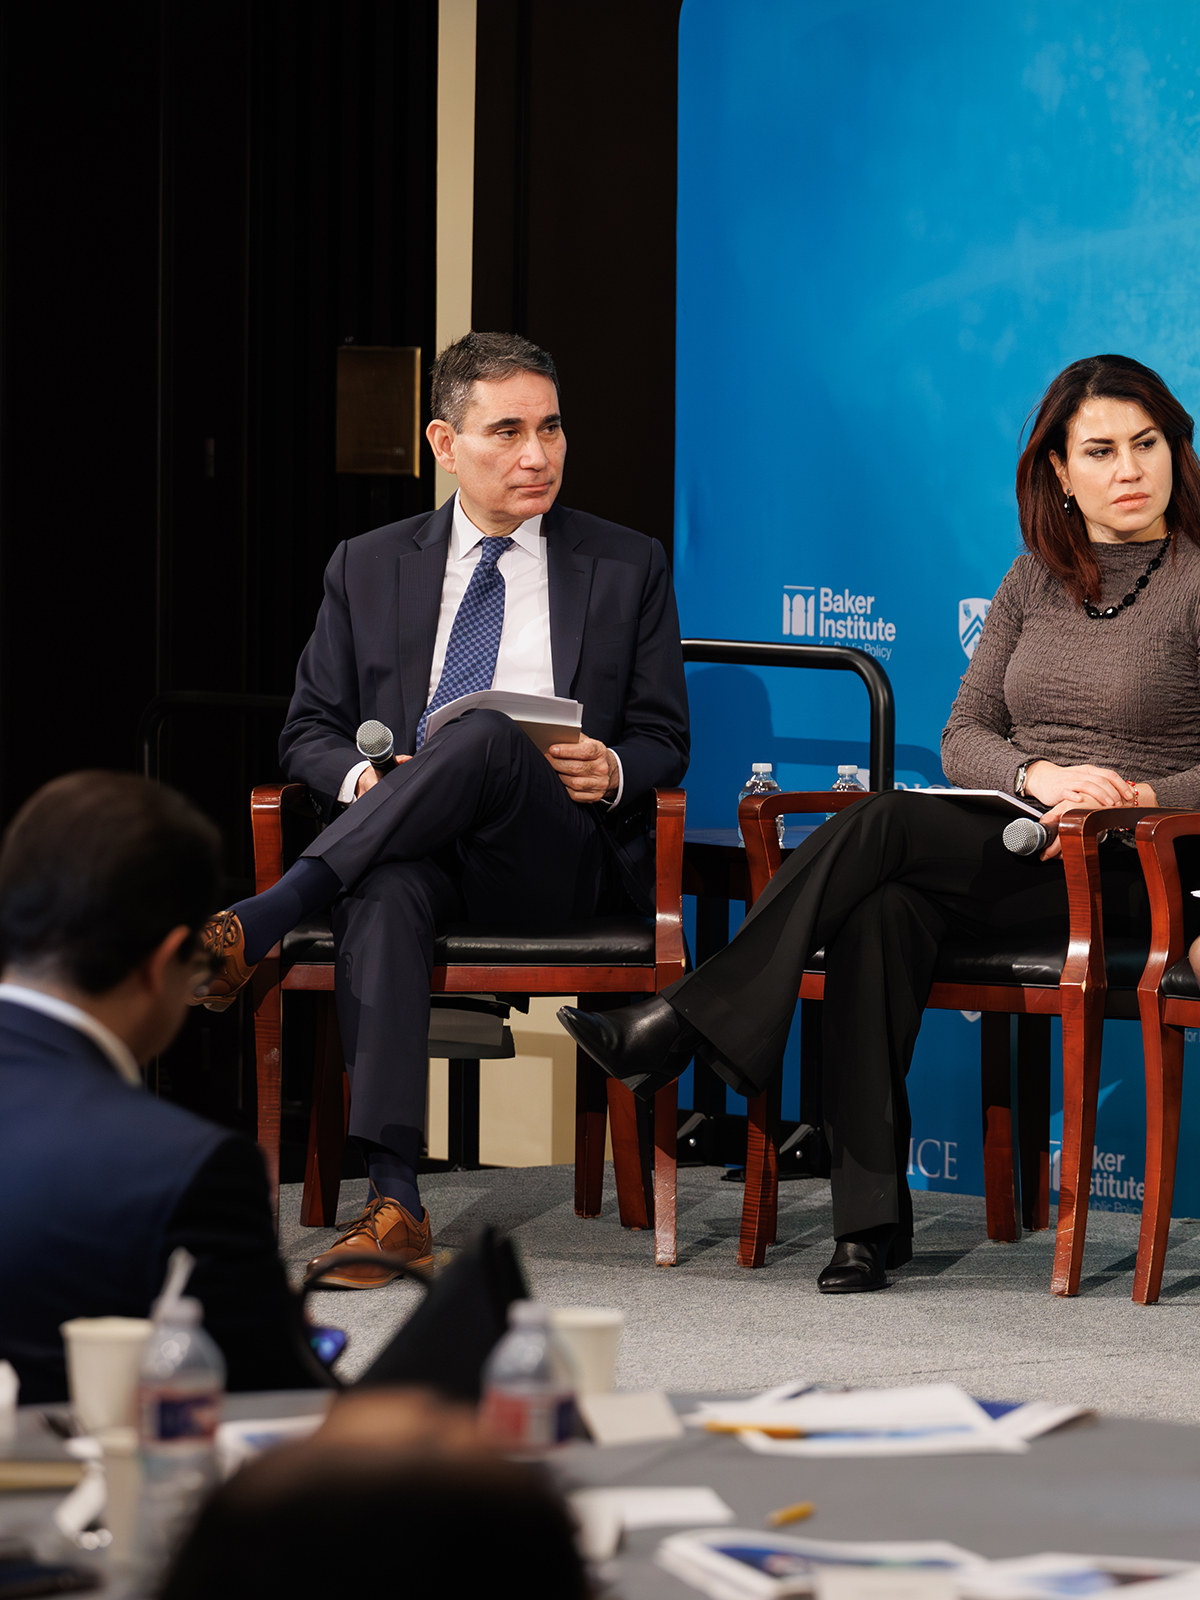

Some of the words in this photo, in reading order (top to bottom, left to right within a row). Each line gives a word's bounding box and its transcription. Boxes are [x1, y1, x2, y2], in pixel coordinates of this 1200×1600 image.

[820, 587, 875, 614] Baker
[819, 612, 896, 642] Institute
[906, 1137, 958, 1181] ICE
